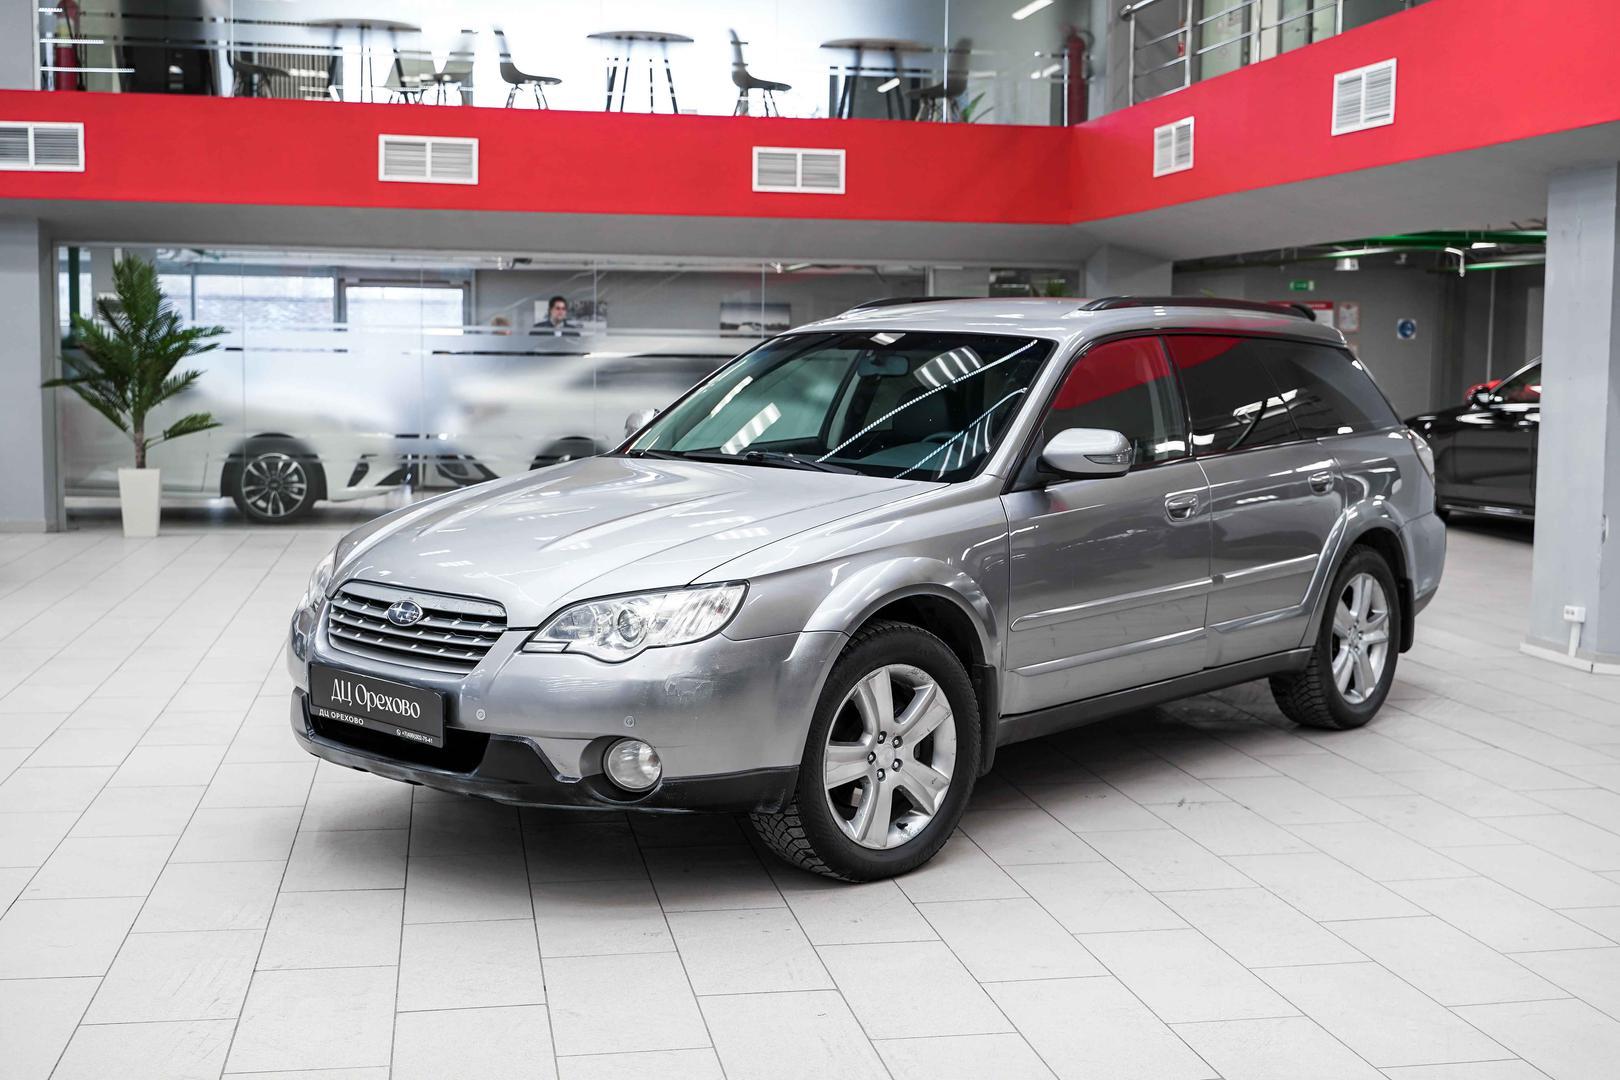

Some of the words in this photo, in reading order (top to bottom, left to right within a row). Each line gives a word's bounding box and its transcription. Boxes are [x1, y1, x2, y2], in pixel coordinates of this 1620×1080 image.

[331, 678, 352, 706] ДЦ
[355, 683, 420, 718] Орехово
[319, 709, 330, 718] ДЦ
[330, 711, 364, 726] ОРЕХОВО
